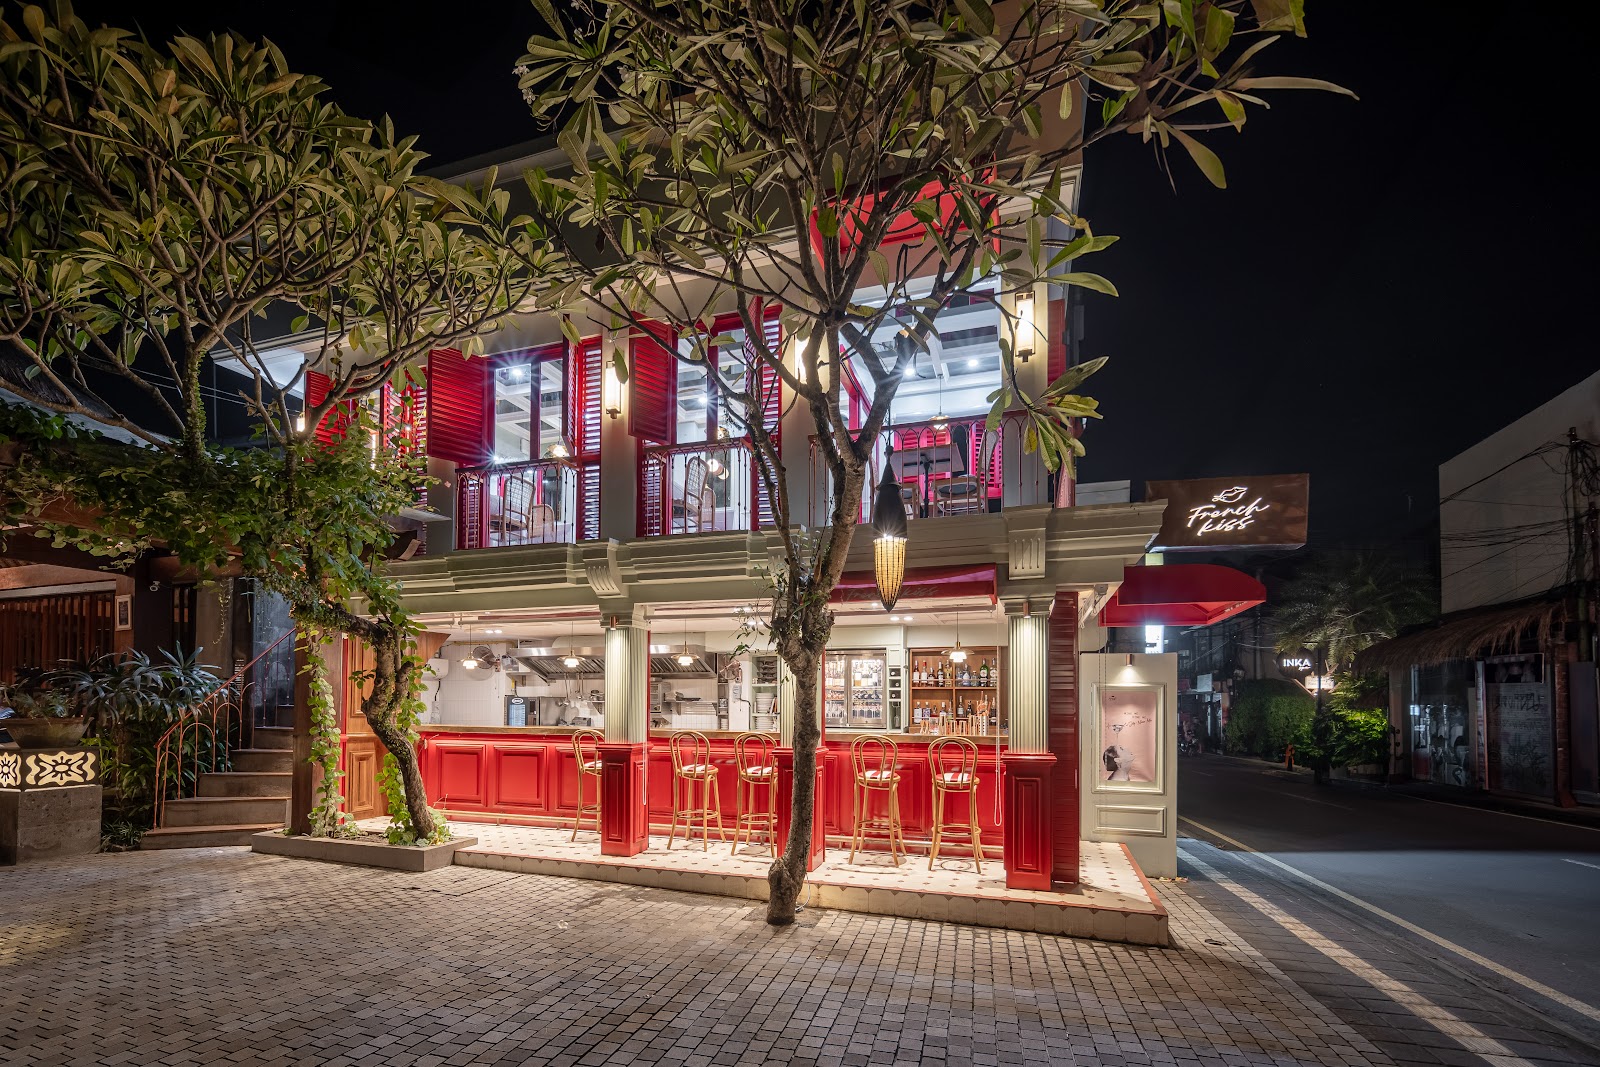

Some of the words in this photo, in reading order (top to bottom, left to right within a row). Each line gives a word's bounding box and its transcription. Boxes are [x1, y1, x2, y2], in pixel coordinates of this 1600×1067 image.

[1187, 498, 1270, 527] French
[1197, 515, 1254, 536] kiss
[846, 588, 883, 602] Fren
[1283, 658, 1311, 667] INKA
